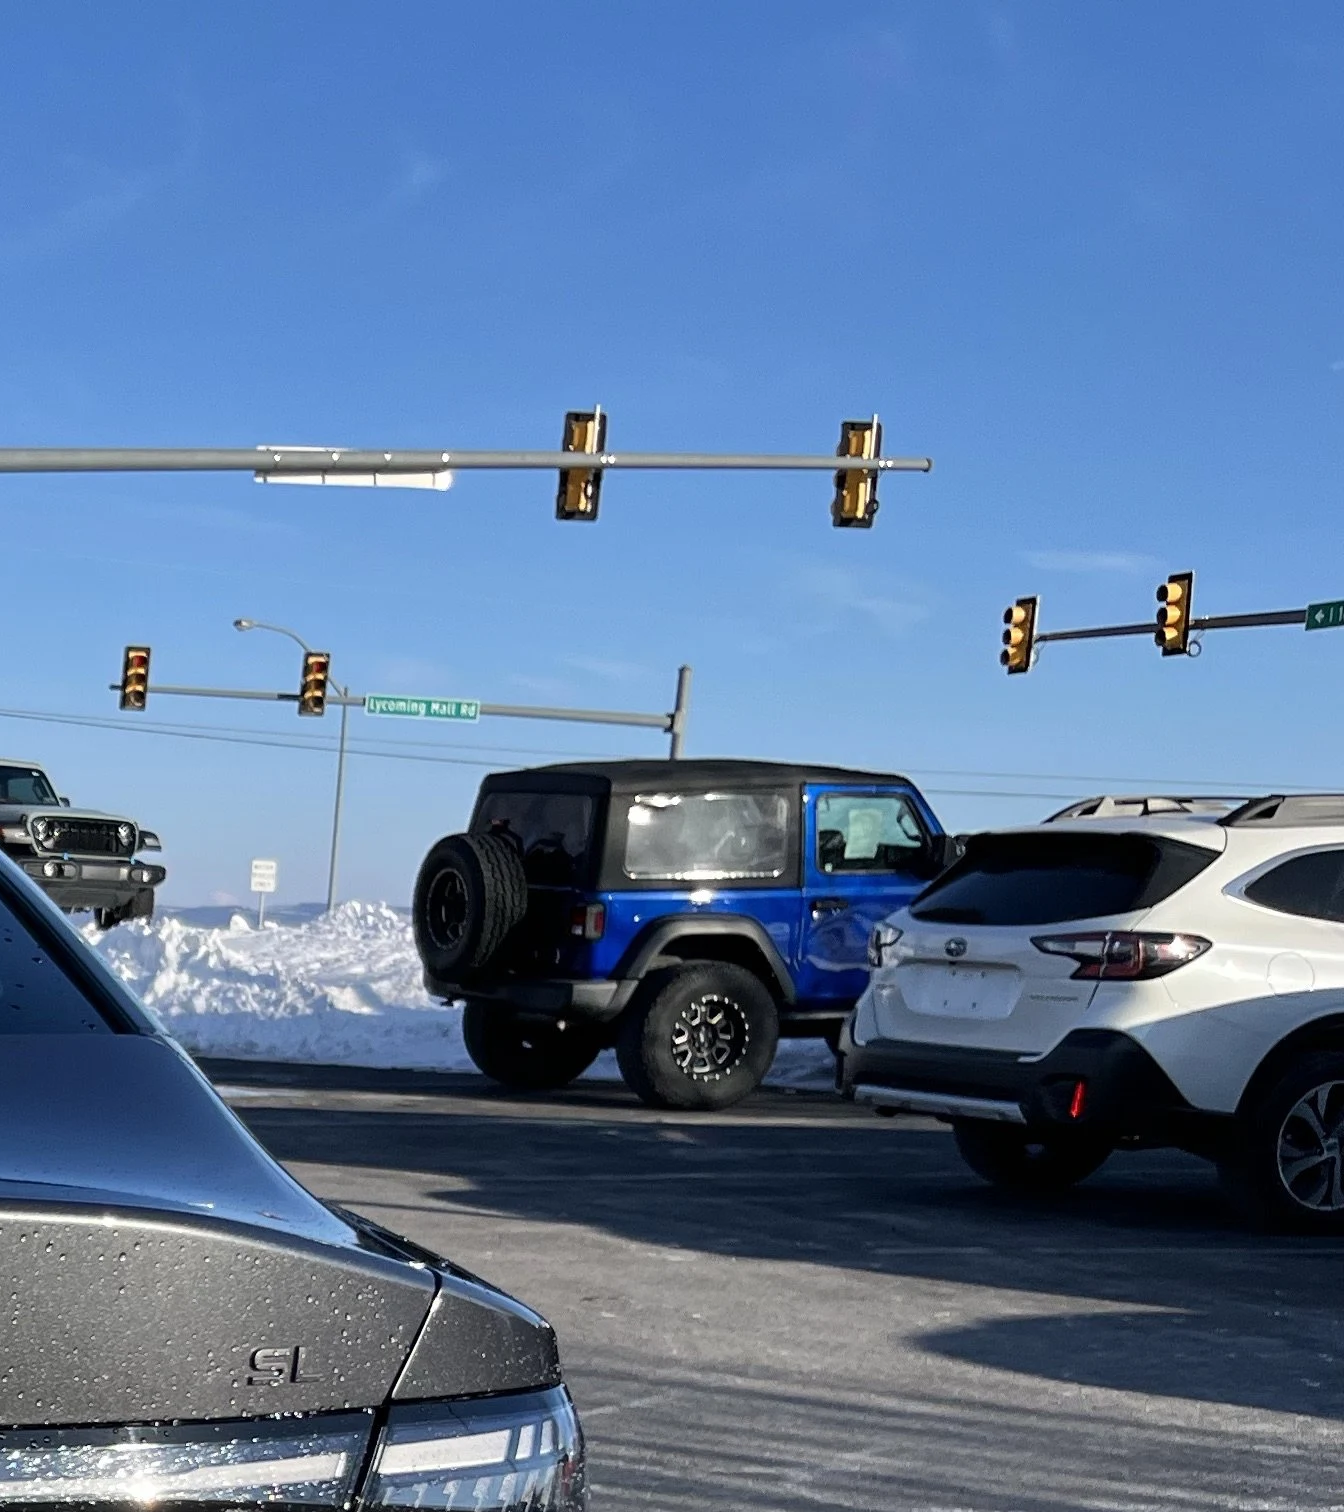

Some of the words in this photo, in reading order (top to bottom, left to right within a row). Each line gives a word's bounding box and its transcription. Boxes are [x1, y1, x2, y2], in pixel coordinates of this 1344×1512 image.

[370, 699, 426, 716] Lycoming
[430, 701, 456, 716] Mall
[460, 703, 476, 717] Rd
[247, 1346, 326, 1386] SL
